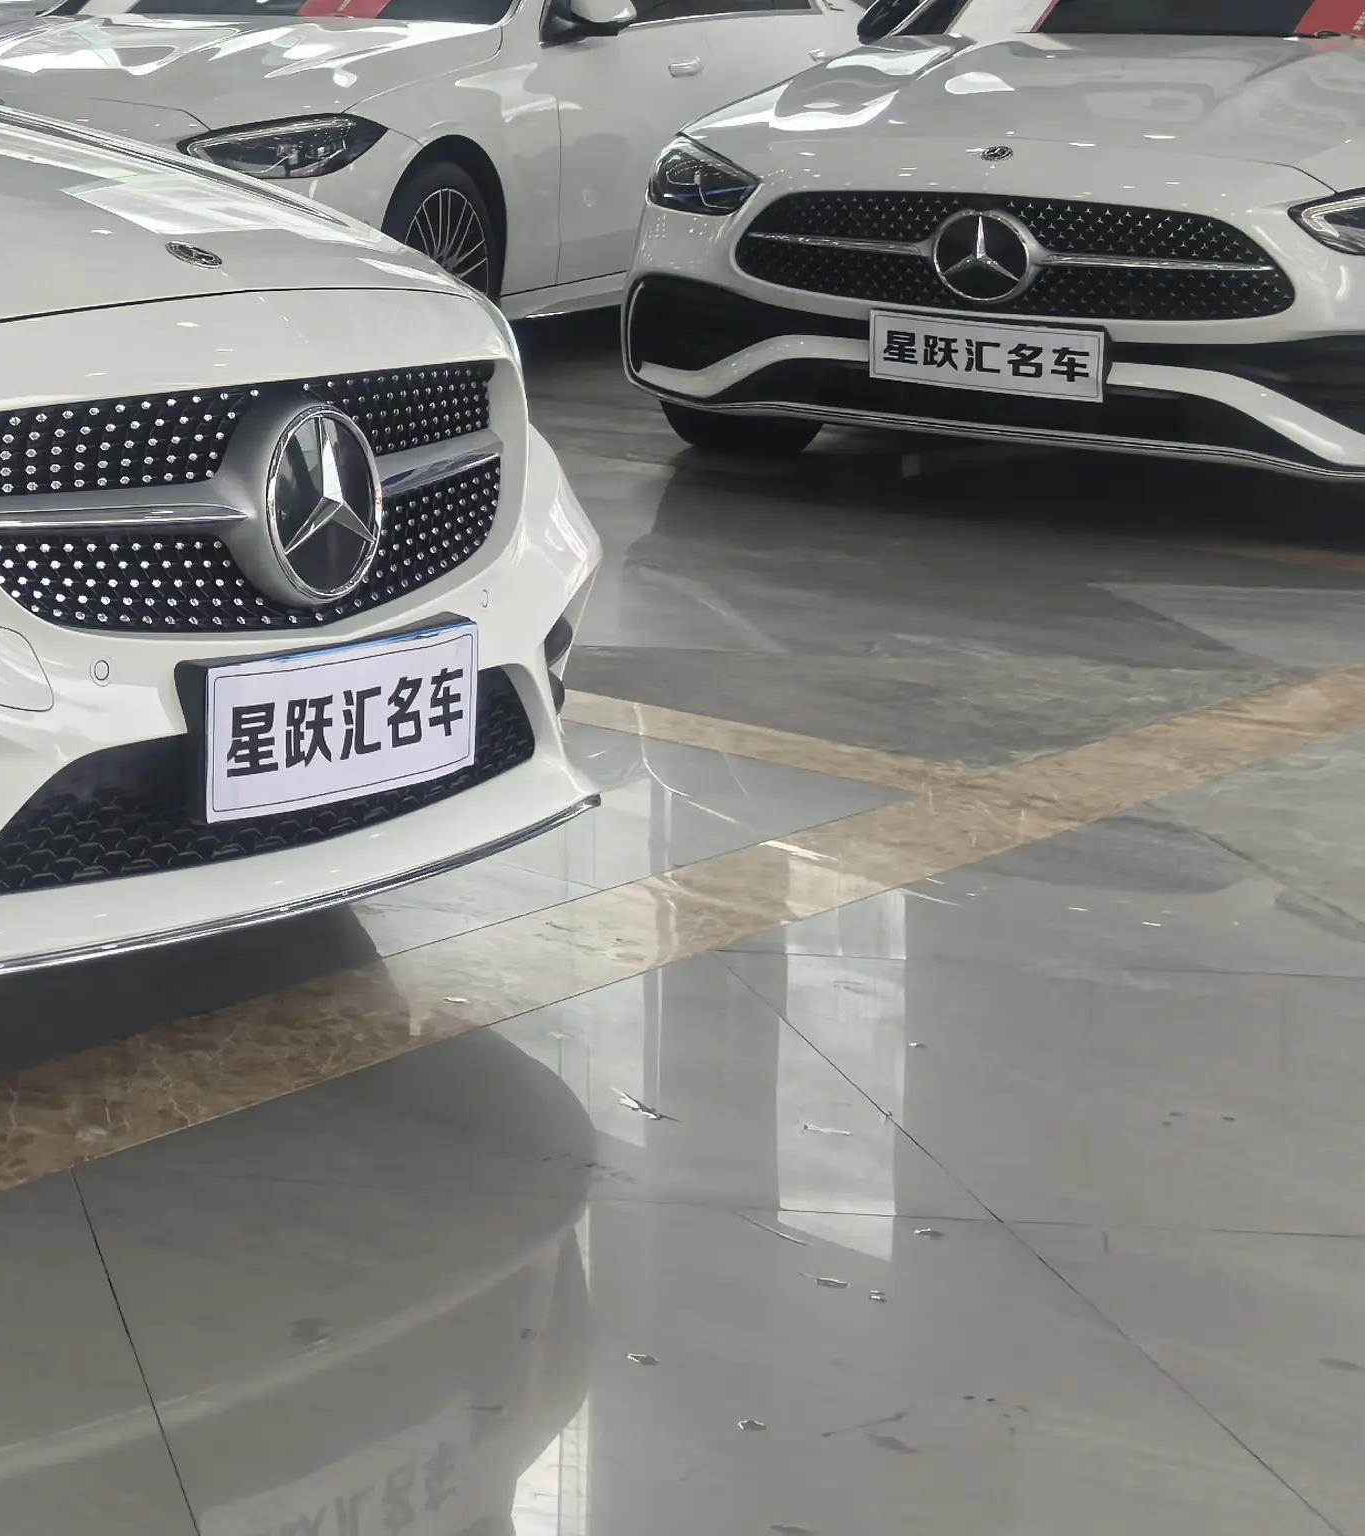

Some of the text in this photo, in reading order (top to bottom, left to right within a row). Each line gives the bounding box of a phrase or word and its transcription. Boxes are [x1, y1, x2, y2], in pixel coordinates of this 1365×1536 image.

[883, 330, 1090, 382] 星跃汇名车
[226, 667, 464, 778] 星跃汇名车
